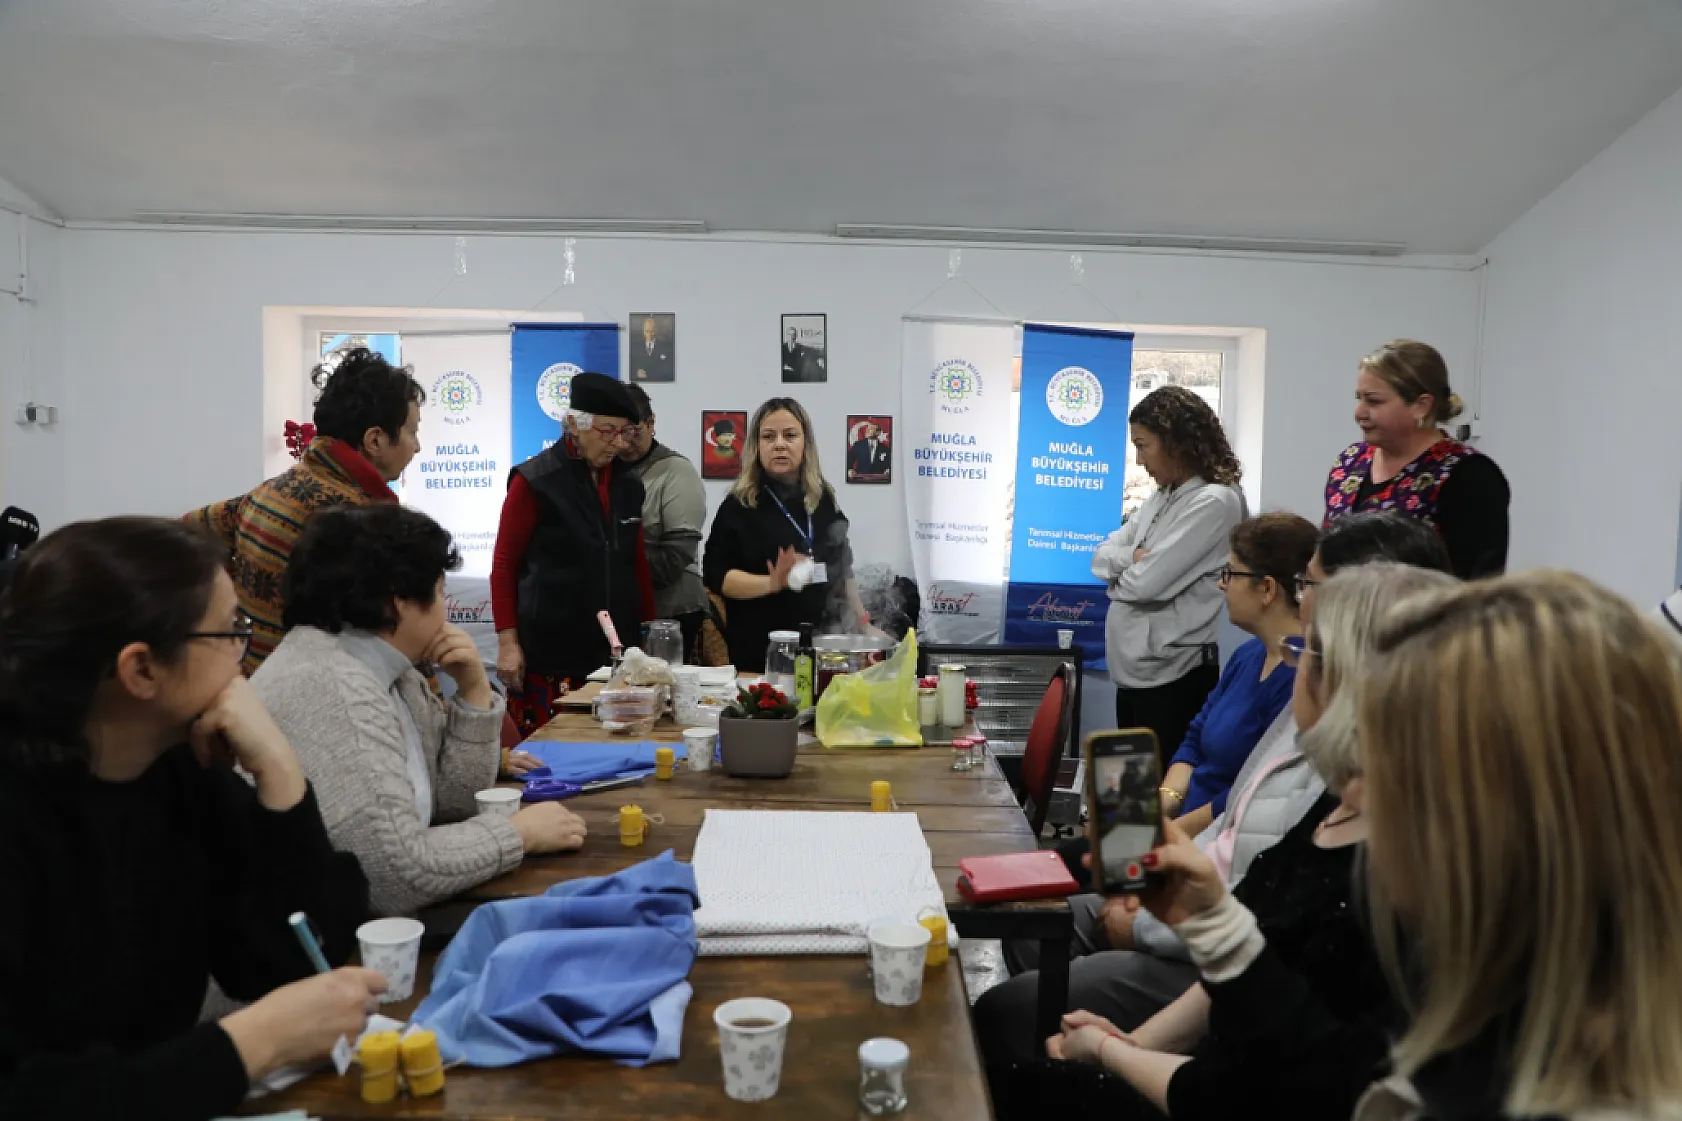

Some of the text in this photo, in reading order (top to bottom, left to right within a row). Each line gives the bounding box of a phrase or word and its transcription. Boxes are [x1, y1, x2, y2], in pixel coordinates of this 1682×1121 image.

[931, 432, 976, 445] MUĞLA
[436, 443, 480, 456] MUĞLA
[914, 448, 993, 464] BÜYÜKŞEHİR
[1048, 441, 1094, 457] MUĞLA
[420, 459, 496, 474] BÜYÜKŞEHİR
[918, 465, 987, 480] BELEDİYESİ
[1032, 456, 1109, 475] BÜYÜKŞEHİR
[425, 477, 492, 489] BELEDİYESİ
[1035, 473, 1104, 490] BELEDİYESİ
[933, 602, 961, 612] ARAS
